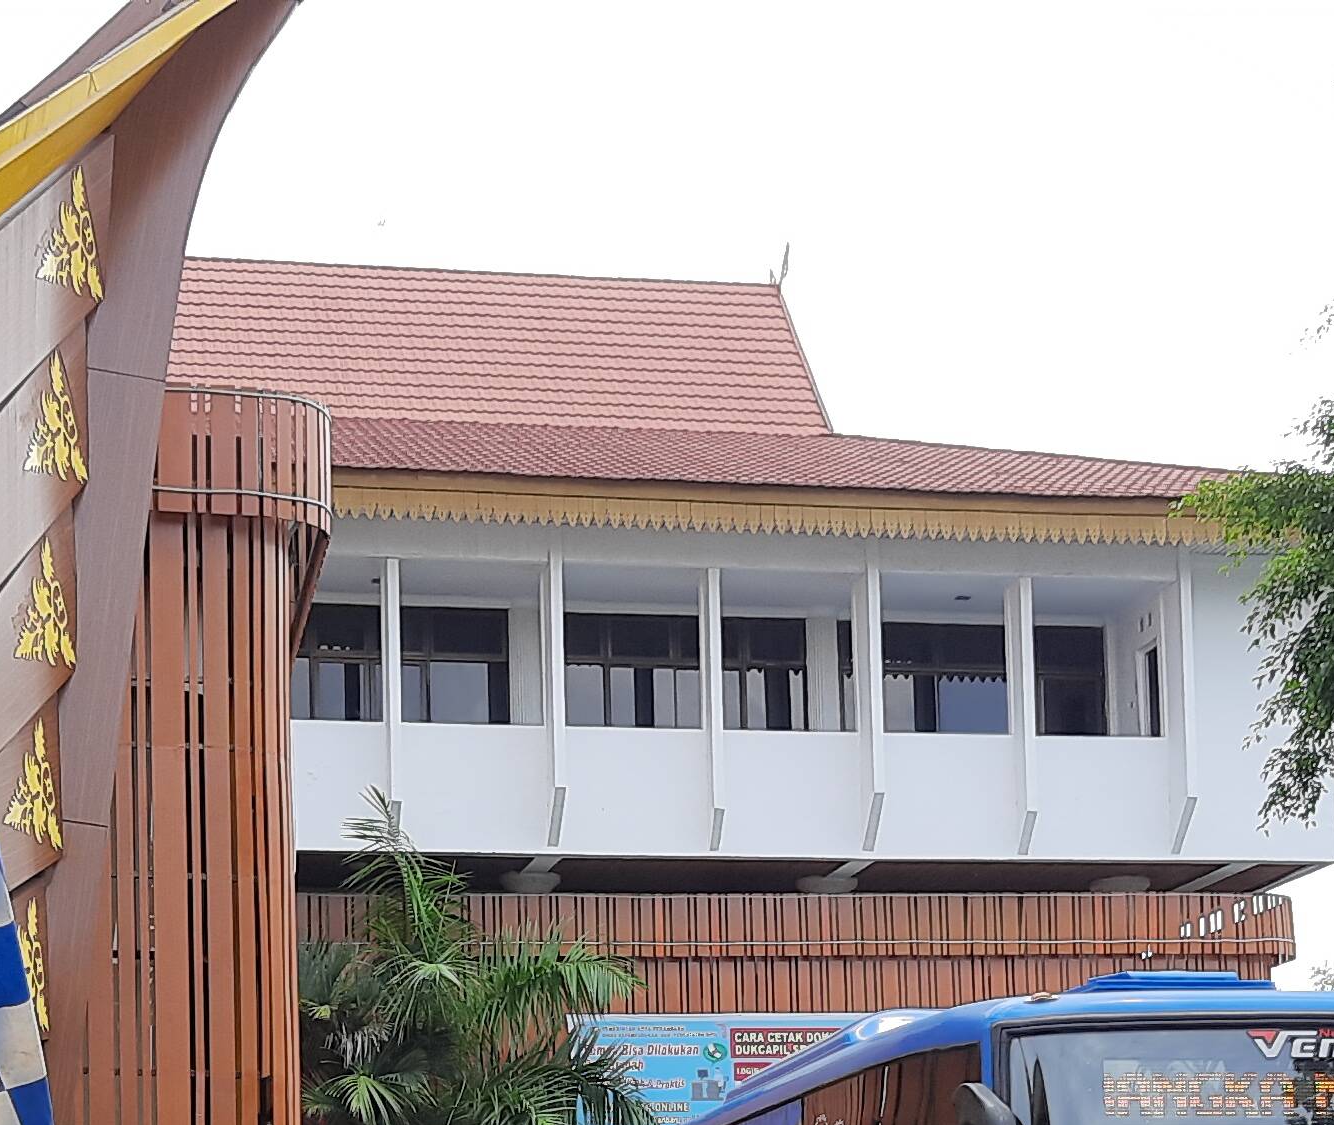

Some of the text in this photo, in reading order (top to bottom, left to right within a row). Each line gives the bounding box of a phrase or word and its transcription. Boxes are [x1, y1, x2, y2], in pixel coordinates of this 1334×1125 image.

[734, 1032, 765, 1044] CARA
[768, 1032, 803, 1044] CETAK
[647, 1044, 699, 1056] Dilakukan
[736, 1044, 790, 1056] DUKCAPIL
[655, 1102, 689, 1112] ONLINE
